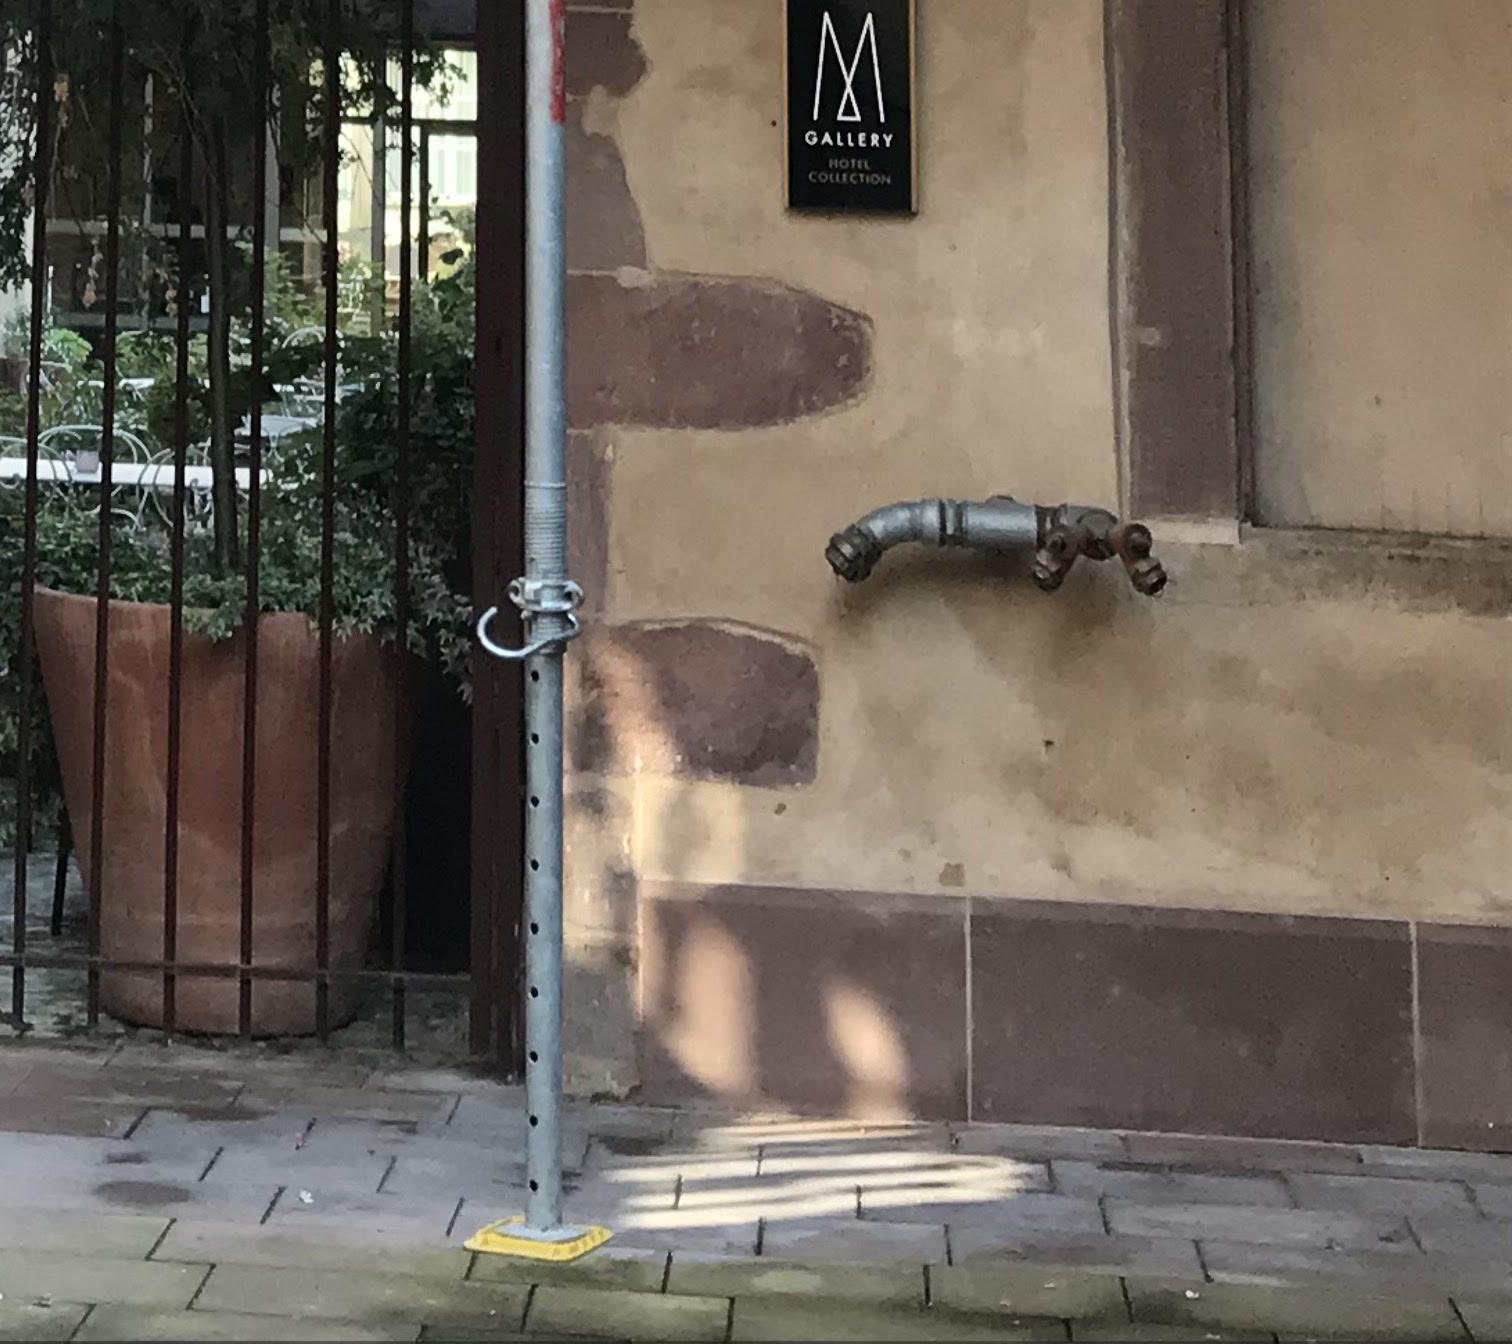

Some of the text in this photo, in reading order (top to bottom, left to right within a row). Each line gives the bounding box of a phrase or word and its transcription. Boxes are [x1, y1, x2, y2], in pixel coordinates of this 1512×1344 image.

[804, 130, 893, 148] GALLERY
[828, 158, 871, 170] HOTEL
[808, 171, 891, 185] COLLECTION
